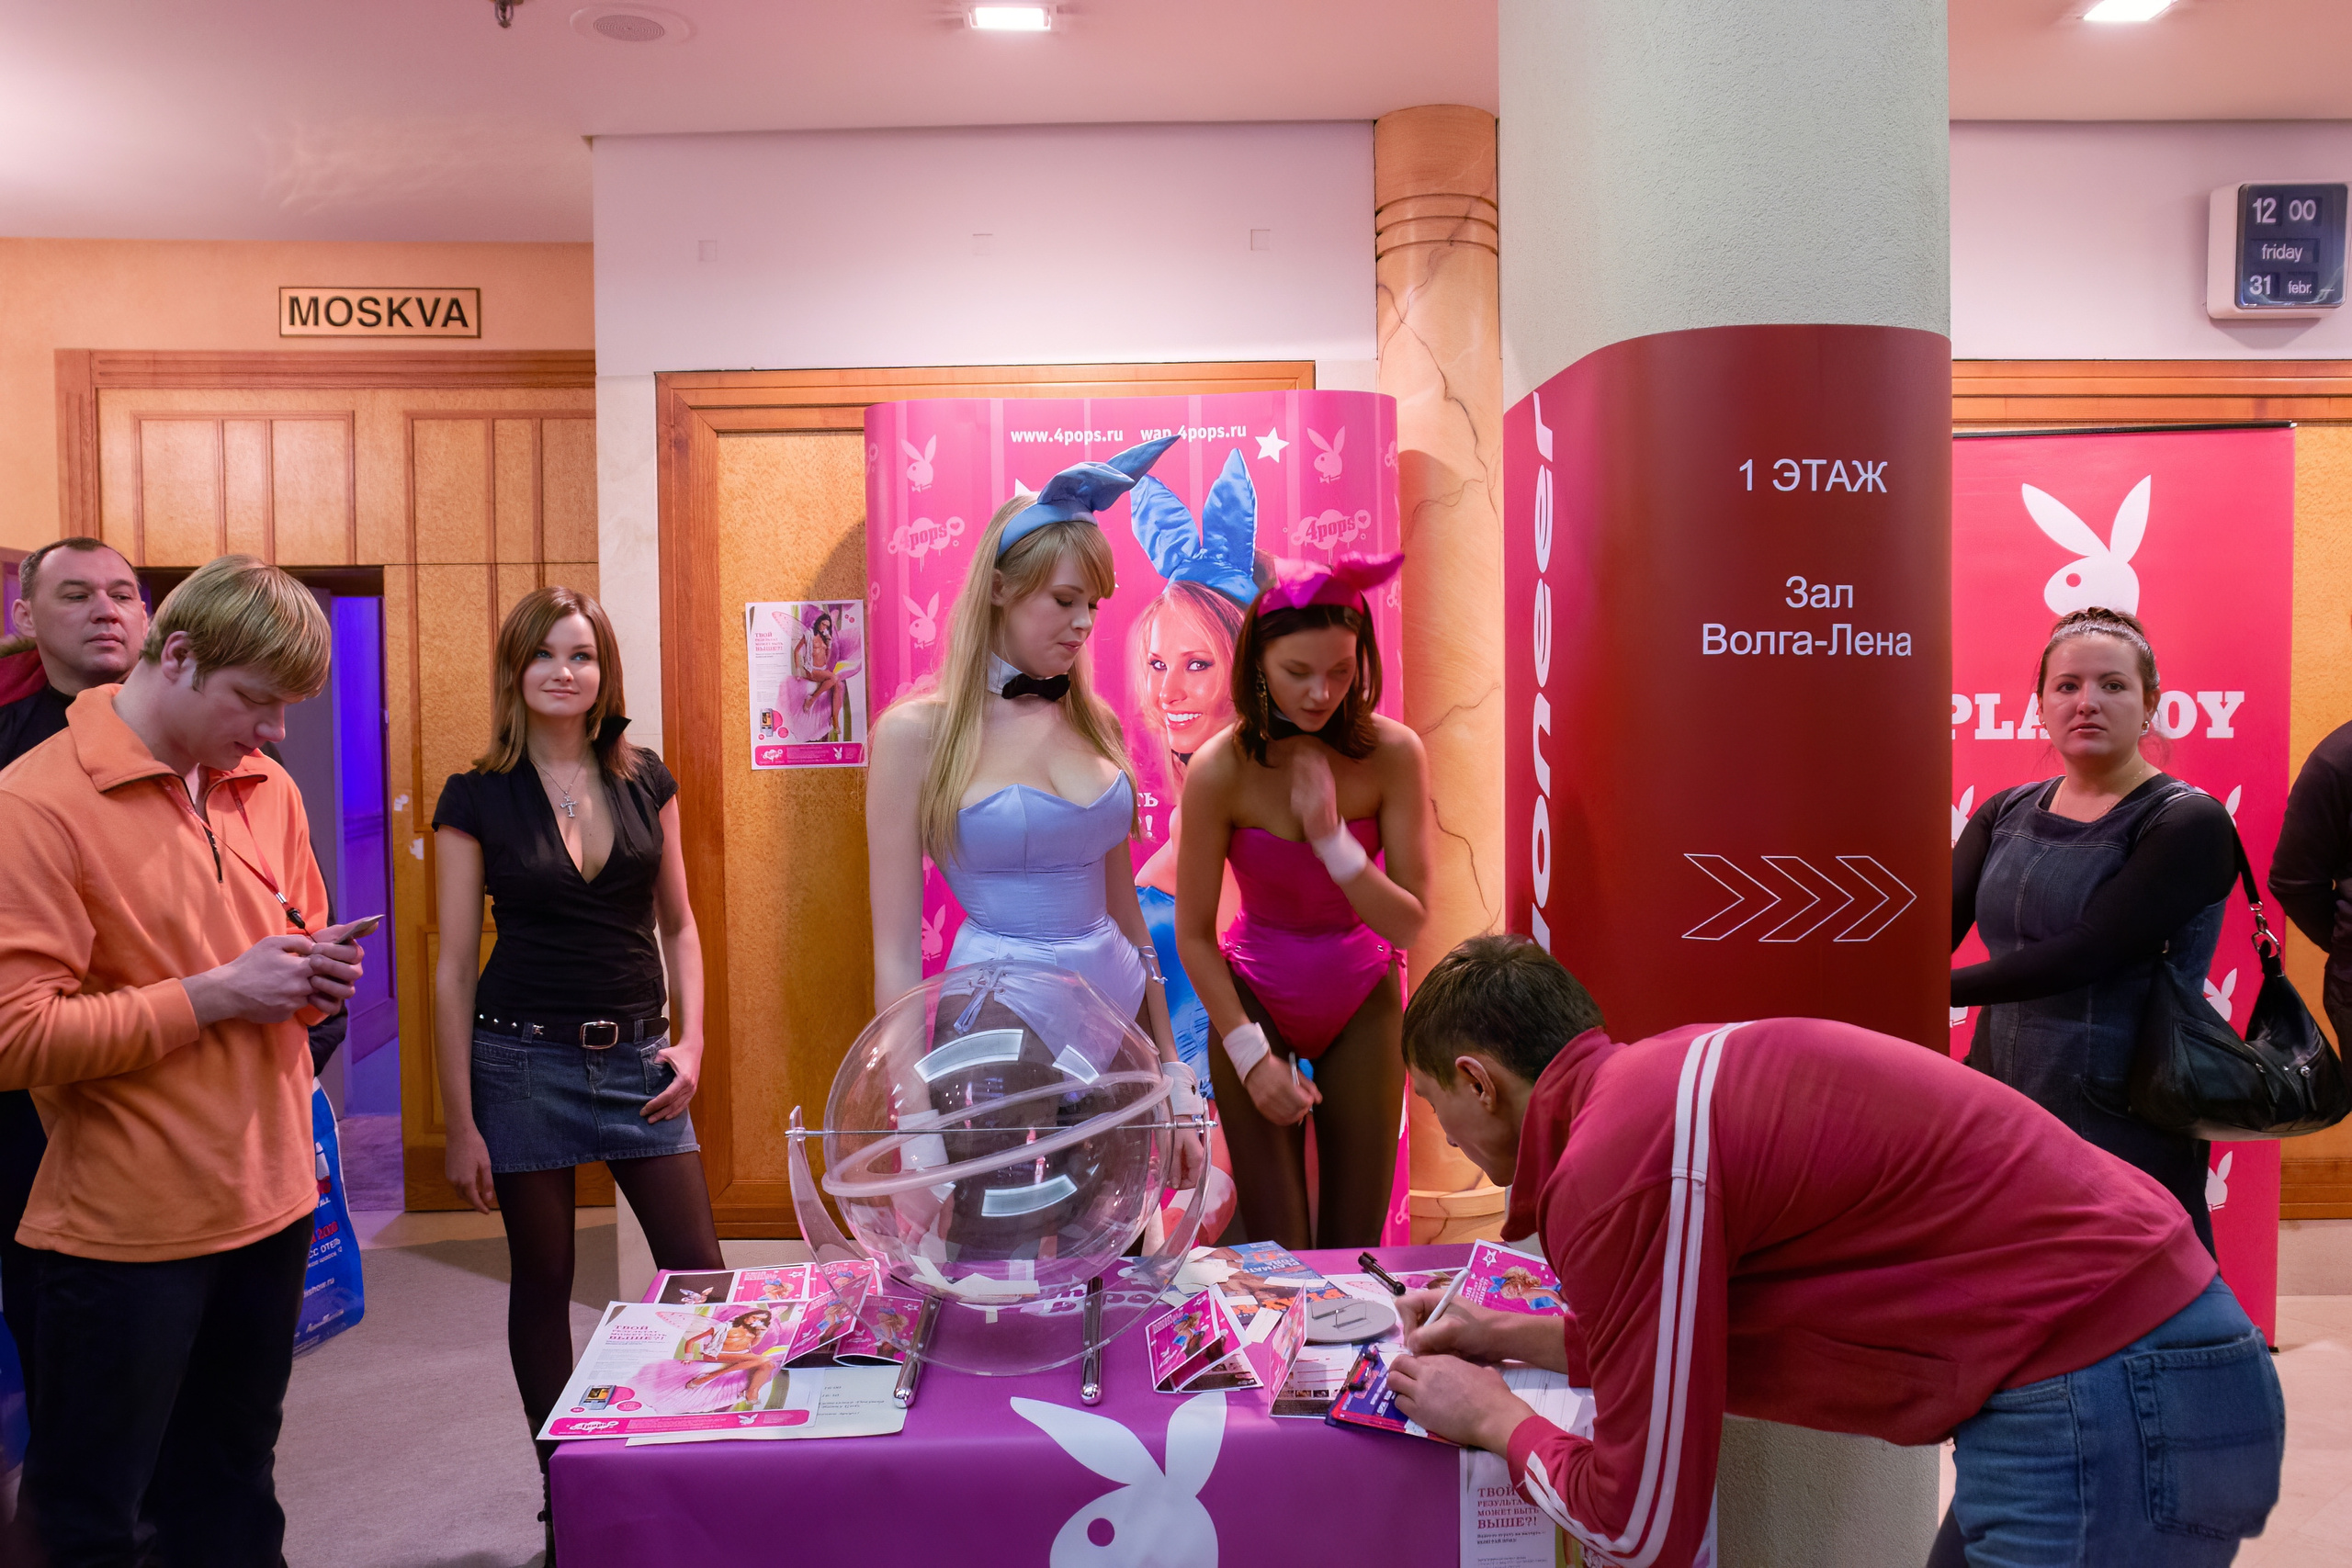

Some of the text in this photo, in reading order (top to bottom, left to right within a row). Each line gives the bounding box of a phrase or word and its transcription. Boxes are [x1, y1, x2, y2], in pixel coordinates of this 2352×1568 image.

[2252, 197, 2317, 223] 12 00
[2261, 243, 2303, 263] friday
[2249, 275, 2312, 295] 31 febr.
[288, 295, 469, 328] MOSKVA
[1010, 424, 1248, 446] www.4pops.ru wap4pops.ru
[1738, 457, 1888, 493] 1 ЭТАЖ
[899, 525, 948, 551] 4pops
[1306, 517, 1356, 543] 4pops
[1785, 575, 1854, 609] Зал
[1702, 623, 1913, 657] Волга-Лена
[1531, 390, 1554, 956] ioneer
[1477, 1483, 1517, 1497] ТВОЙ
[1477, 1498, 1527, 1507] РЕЗУЛЬТА
[1477, 1517, 1537, 1529] ВЫШЕ?!
